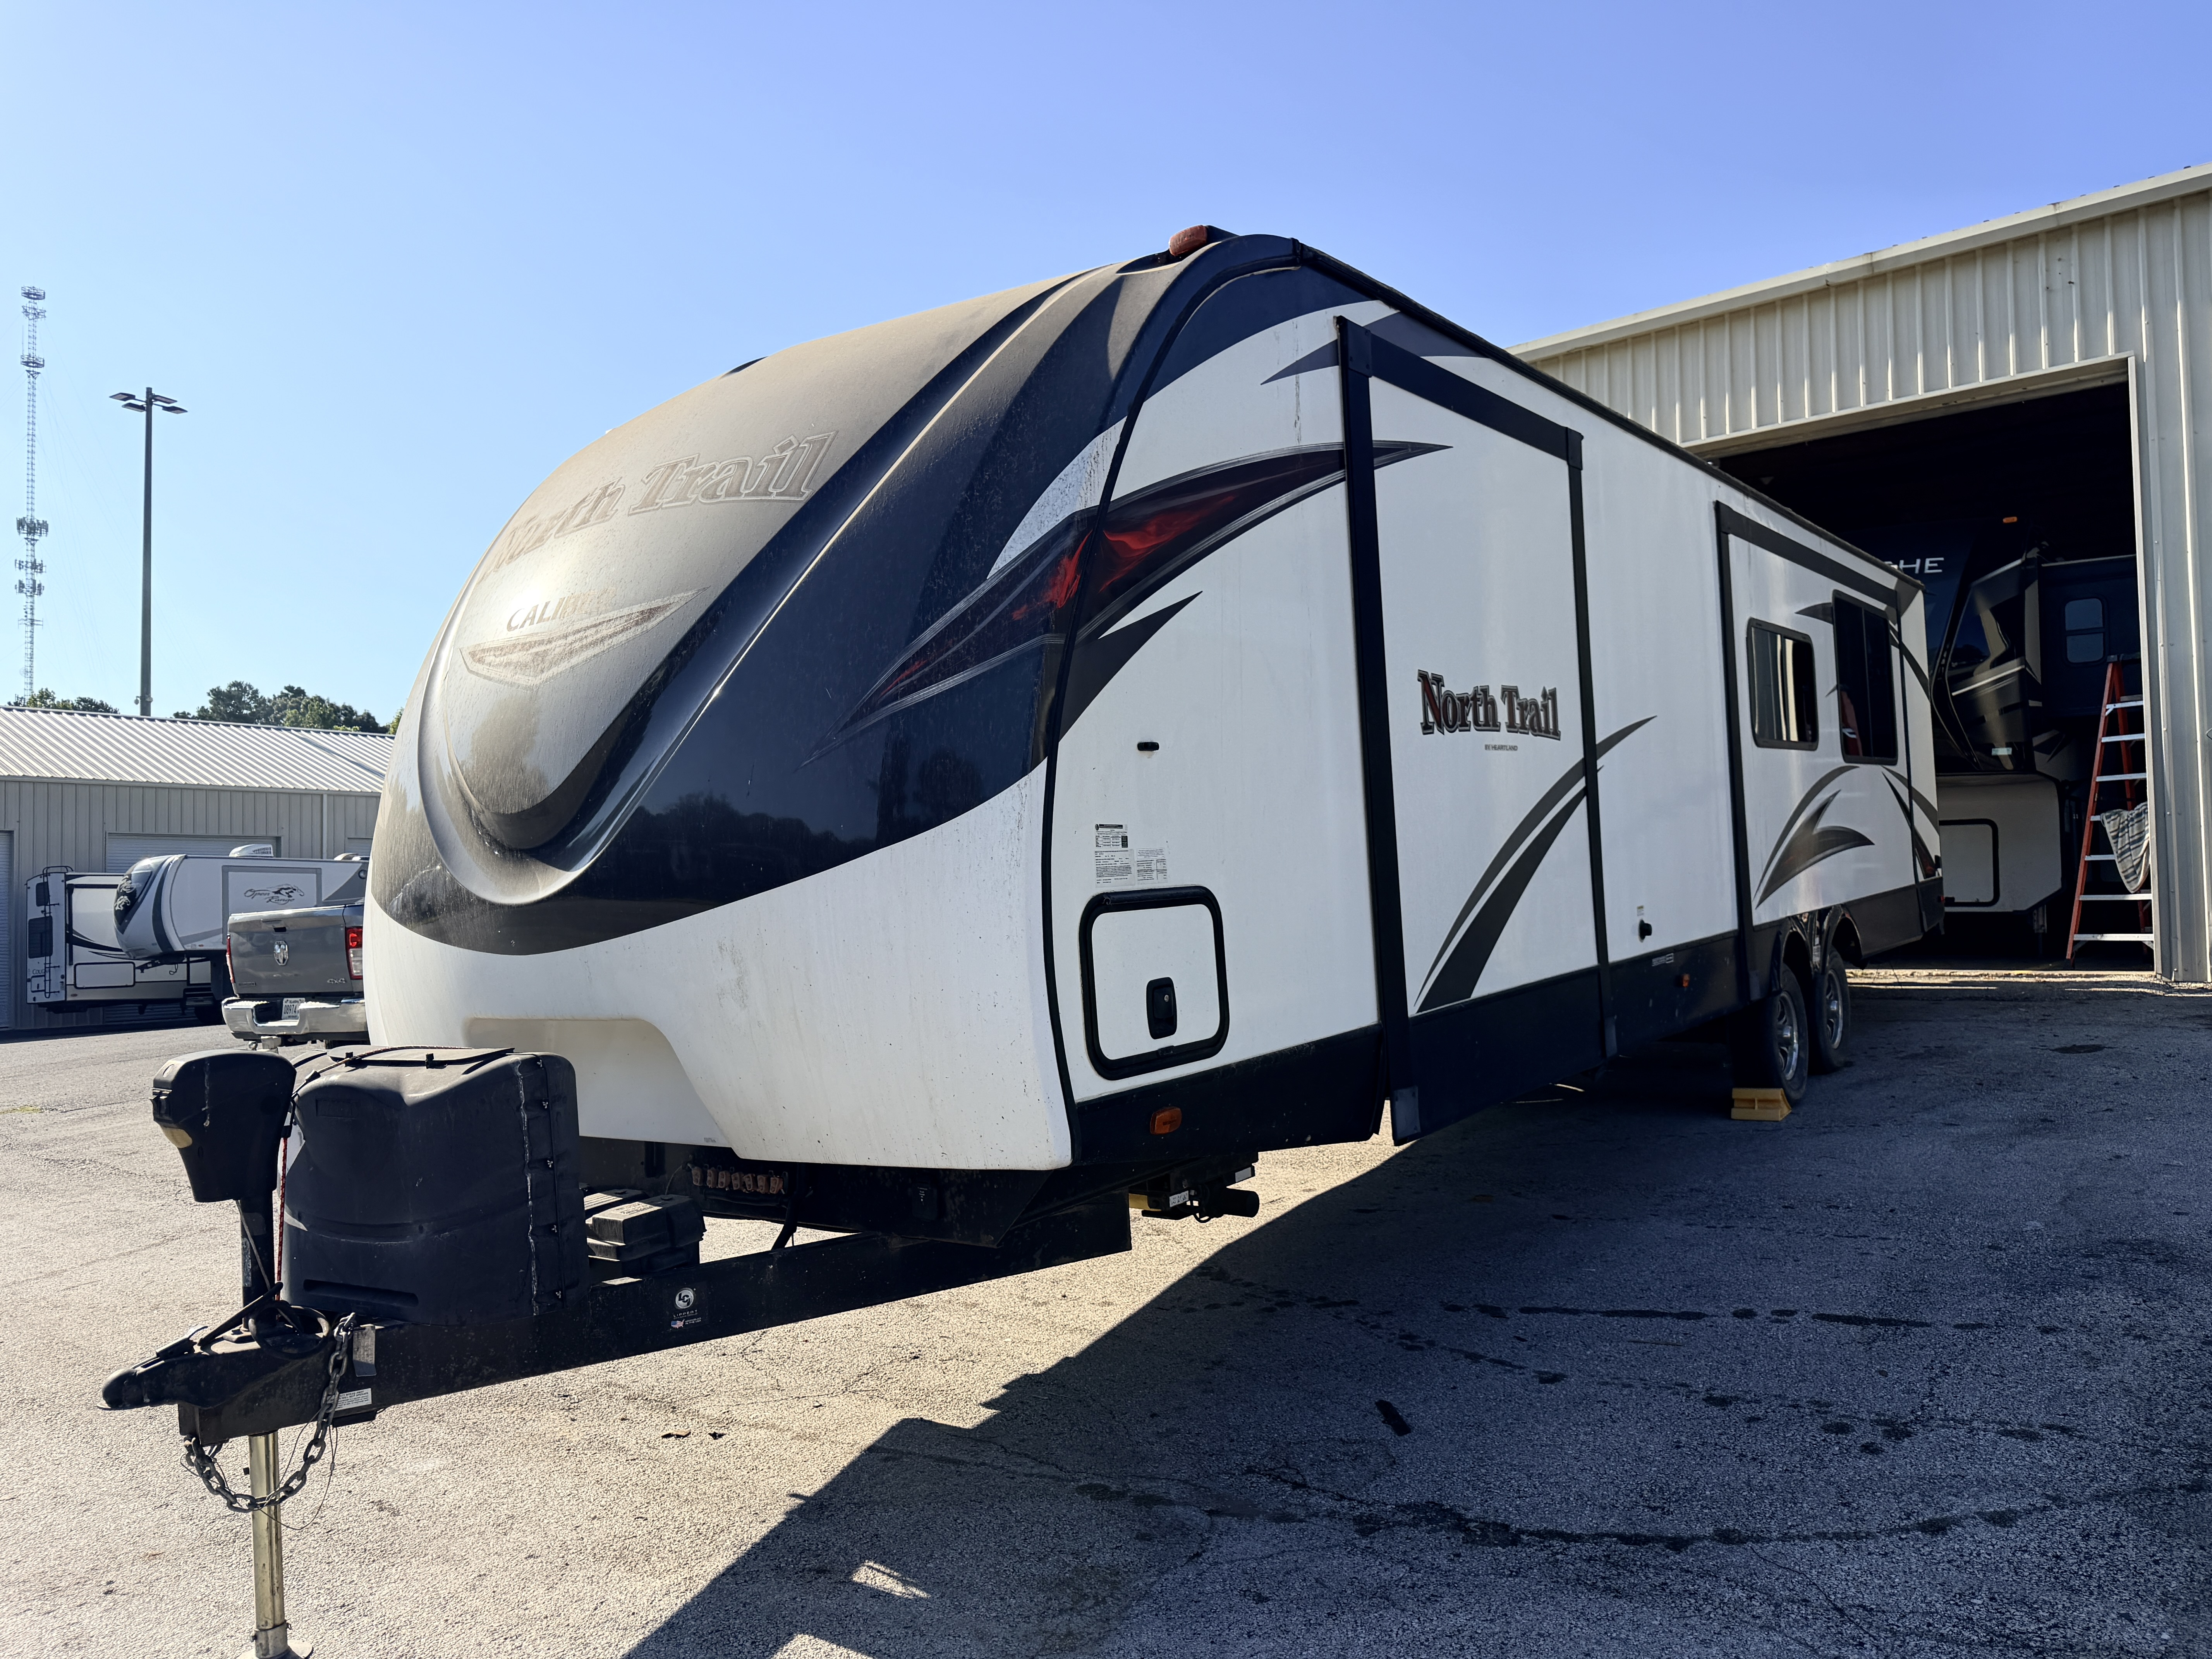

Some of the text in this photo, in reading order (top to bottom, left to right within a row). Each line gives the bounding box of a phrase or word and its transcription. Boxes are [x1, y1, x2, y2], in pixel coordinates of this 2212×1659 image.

[628, 430, 839, 517] Trail
[1884, 558, 1944, 574] HE
[1417, 669, 1561, 741] North Trail
